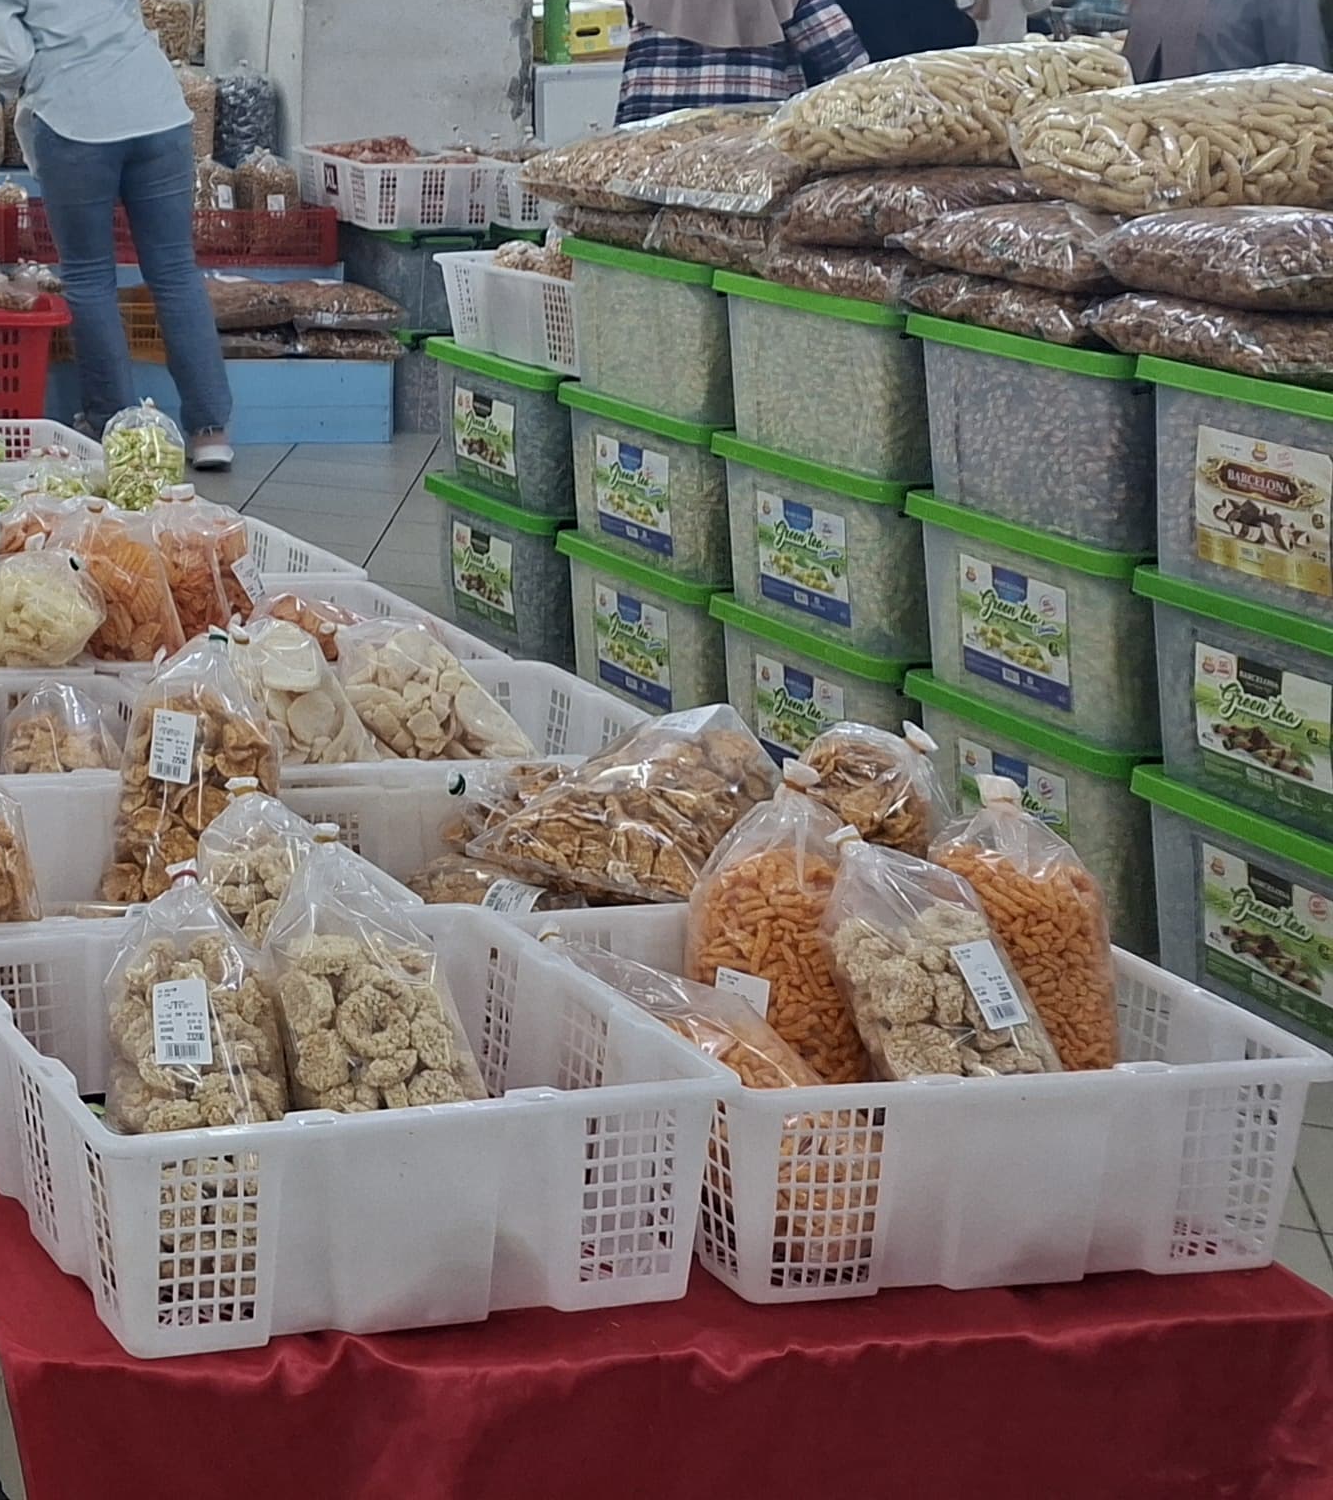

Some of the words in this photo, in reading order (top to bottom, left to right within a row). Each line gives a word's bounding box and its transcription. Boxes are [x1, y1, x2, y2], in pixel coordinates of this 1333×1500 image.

[1227, 469, 1292, 496] BARCELONA
[979, 588, 1016, 620] Green
[1219, 681, 1269, 720] Green
[1270, 696, 1299, 725] tea
[1230, 887, 1278, 923] Green
[1283, 906, 1309, 938] tea
